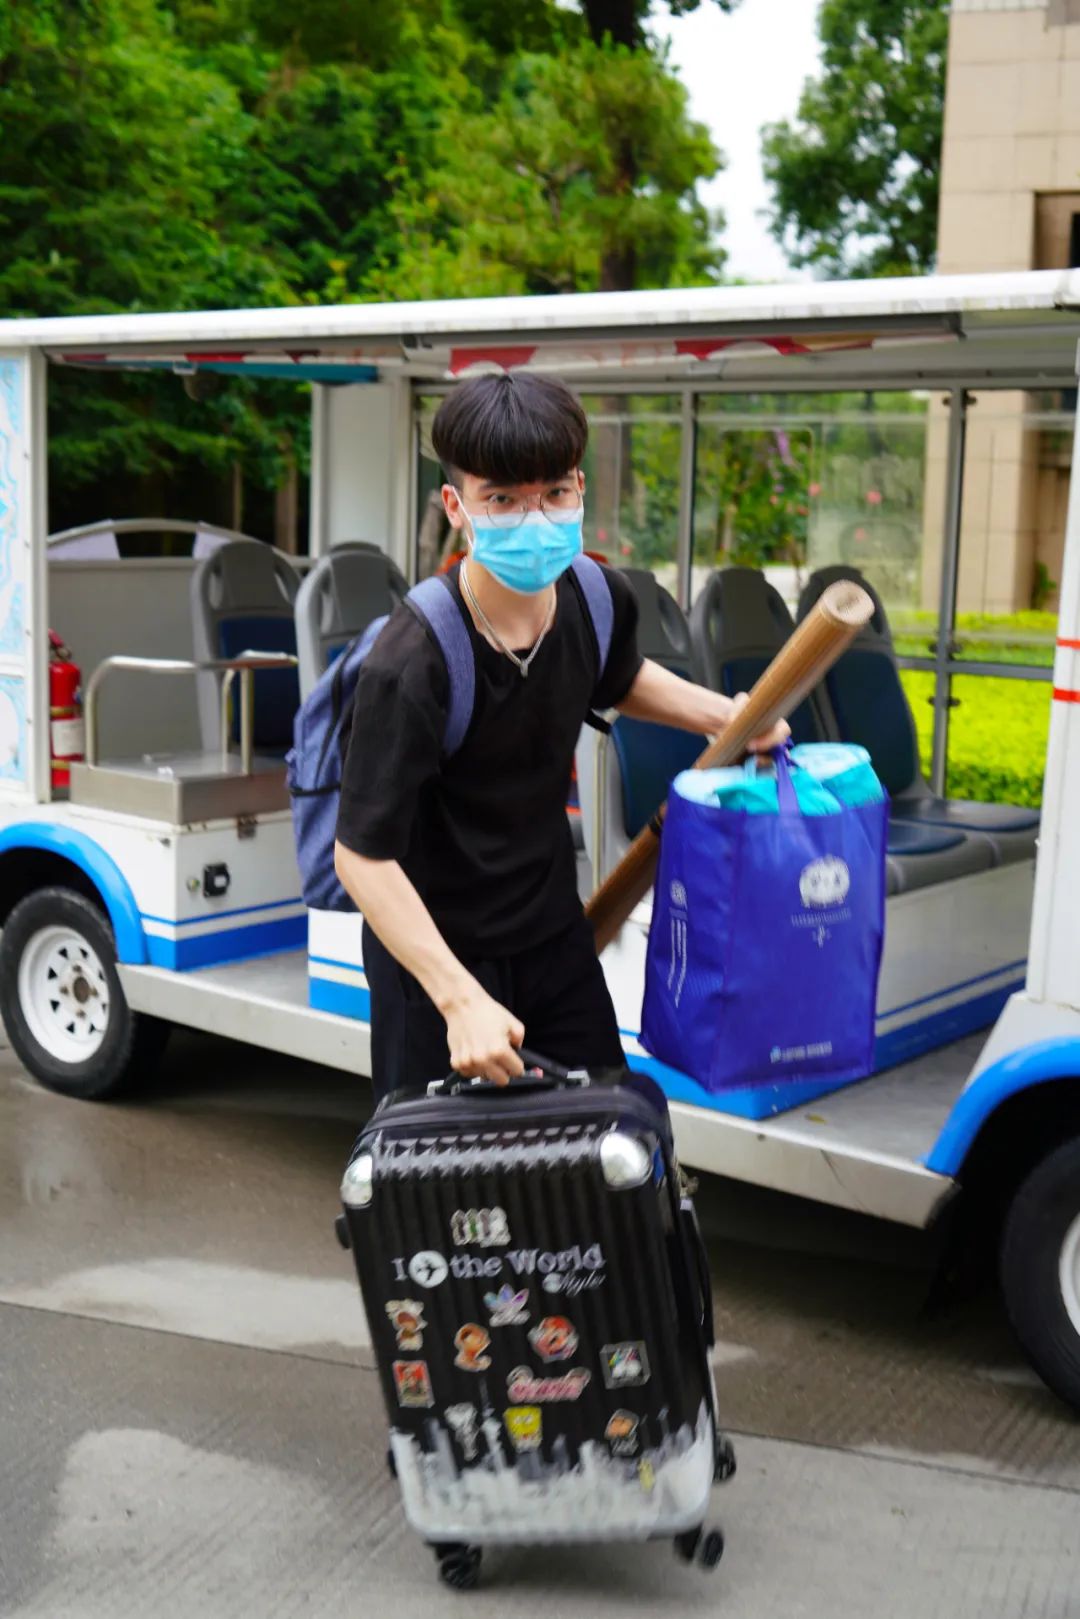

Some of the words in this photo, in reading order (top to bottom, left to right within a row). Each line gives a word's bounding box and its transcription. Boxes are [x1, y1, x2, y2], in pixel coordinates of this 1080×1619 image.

[391, 1258, 408, 1281] I
[450, 1254, 503, 1279] the
[505, 1243, 606, 1275] World
